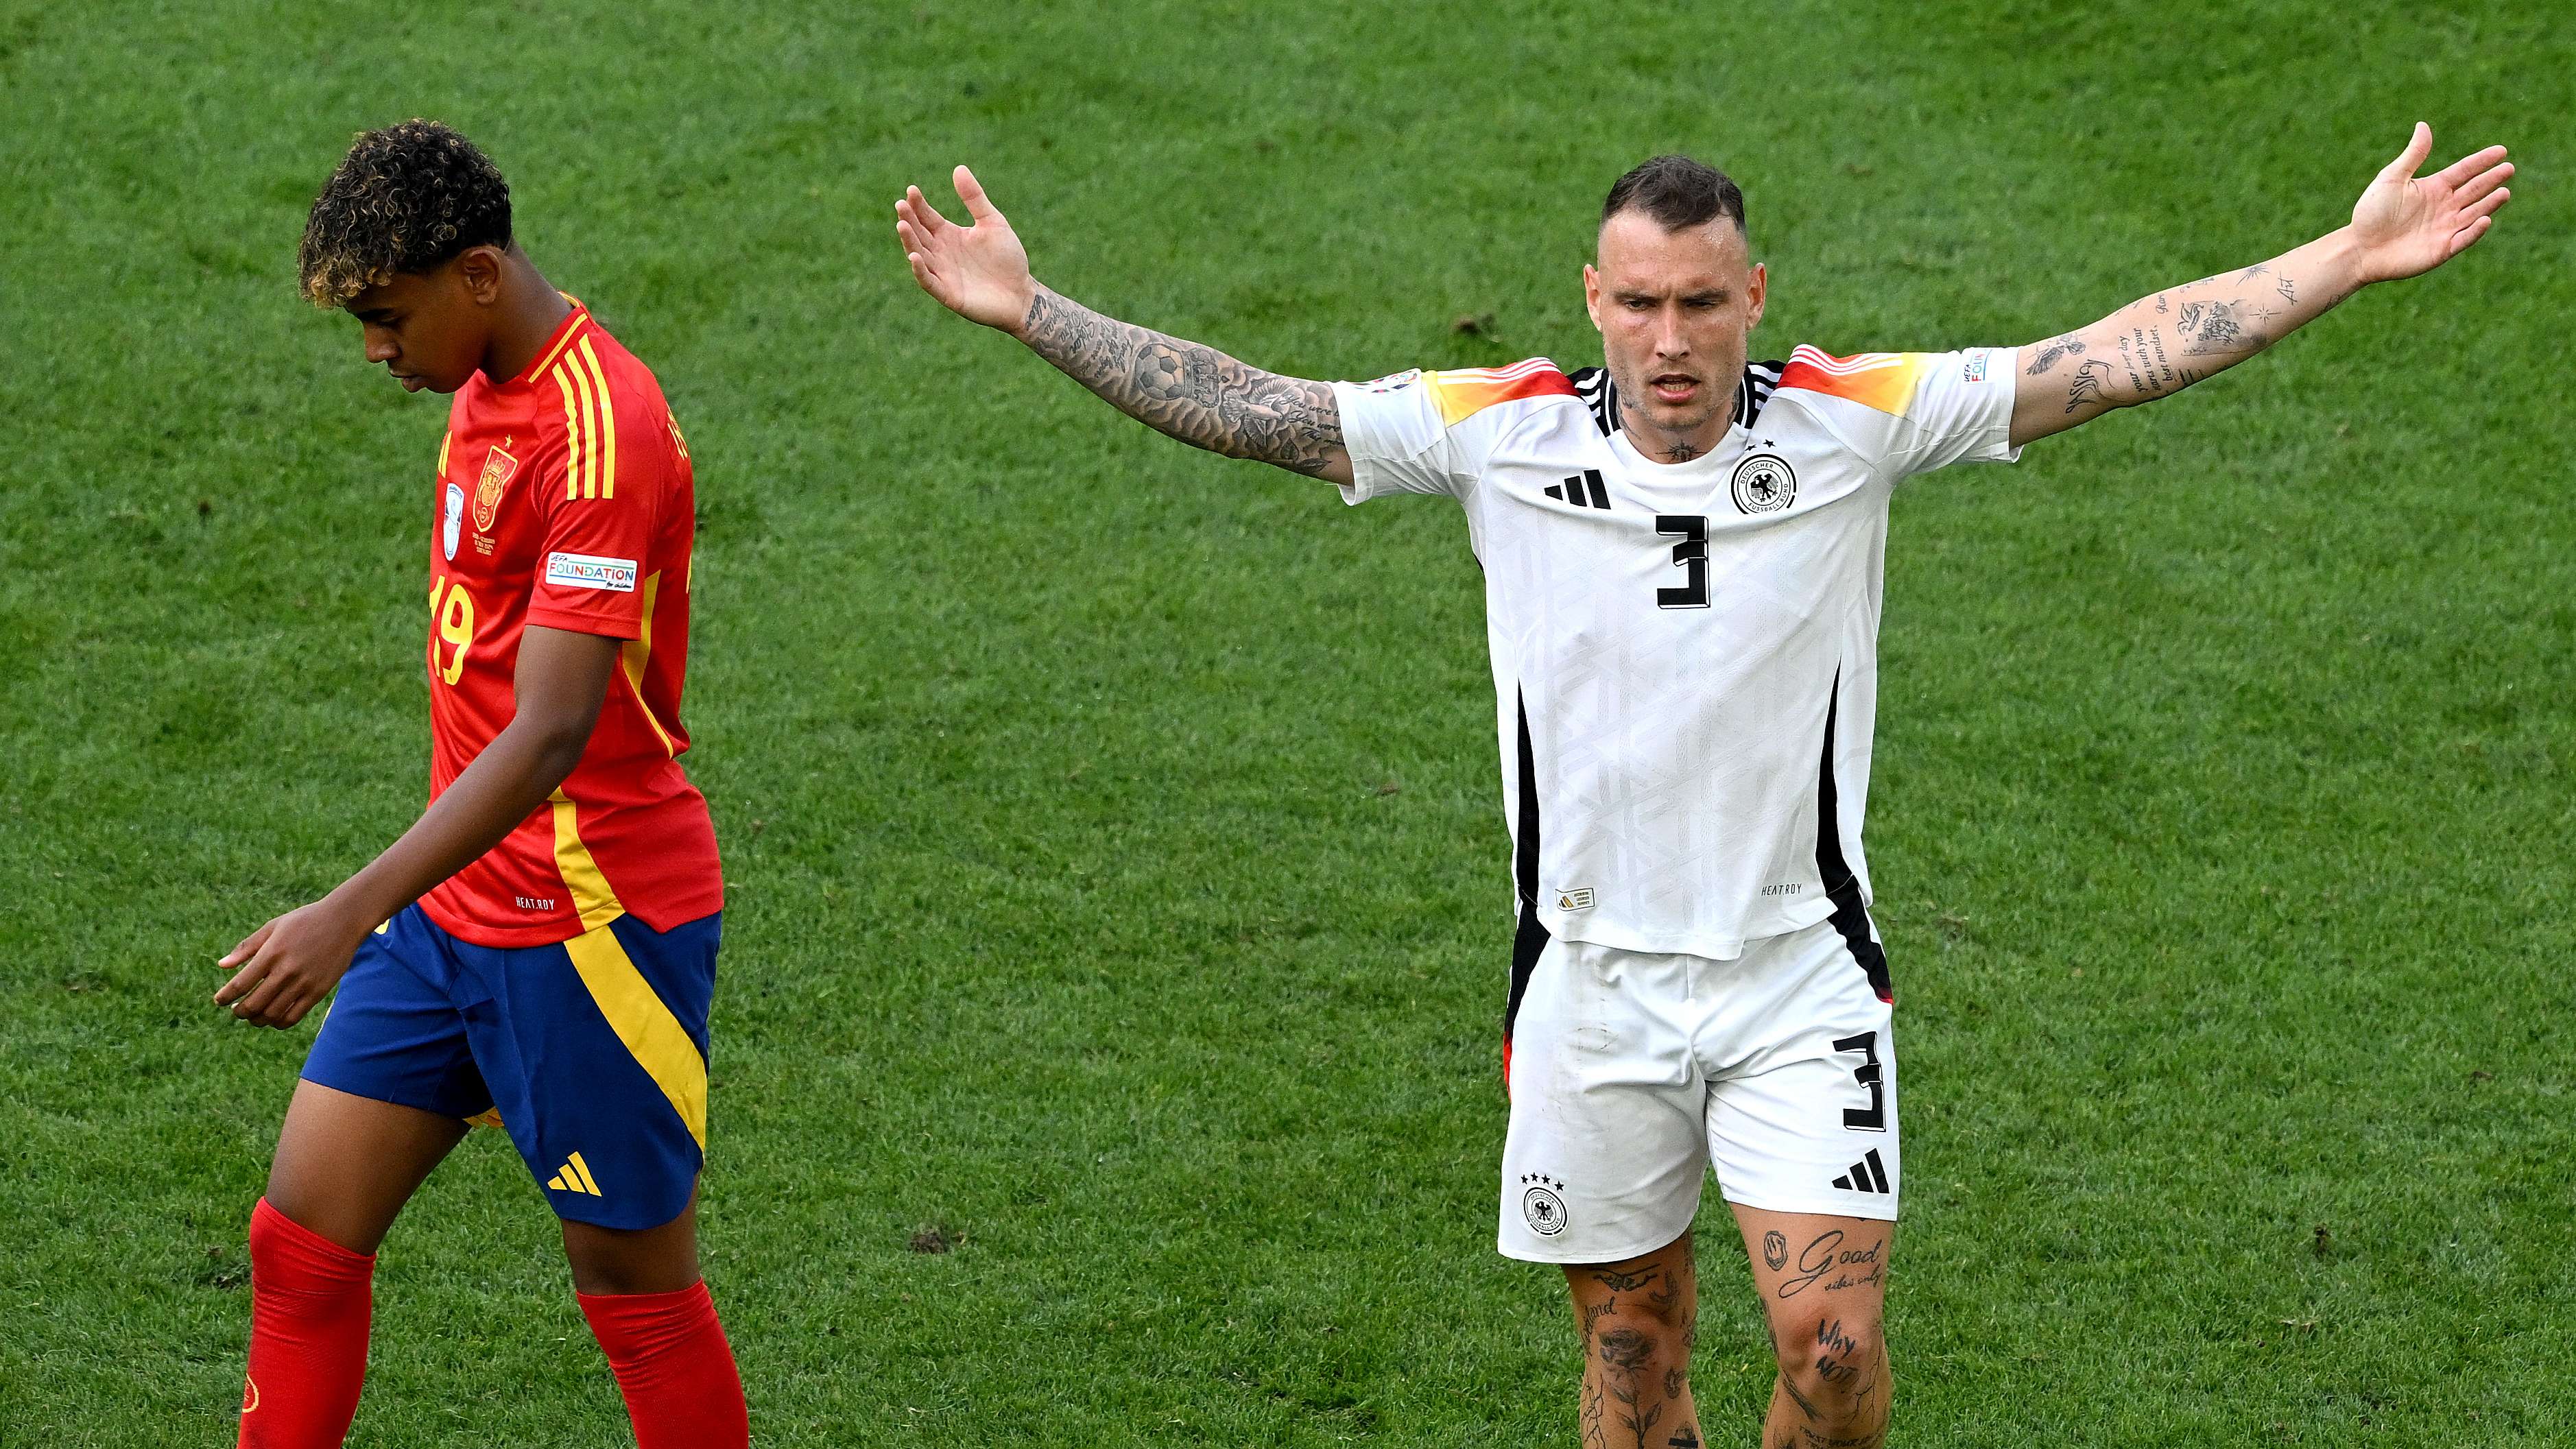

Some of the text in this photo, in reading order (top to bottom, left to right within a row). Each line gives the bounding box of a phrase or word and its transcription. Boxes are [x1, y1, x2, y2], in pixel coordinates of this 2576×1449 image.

[2118, 335, 2130, 352] day
[2133, 328, 2148, 346] your
[2136, 348, 2151, 368] with
[2130, 372, 2148, 392] your
[2161, 364, 2173, 381] best
[1740, 462, 1774, 484] DEUTSCHER
[549, 562, 634, 582] FOUNDATION
[1655, 515, 1711, 609] 3
[429, 575, 475, 686] 19
[515, 896, 555, 911] HEAT.RDY
[1832, 1031, 1887, 1133] 3
[1778, 1229, 1883, 1299] Good
